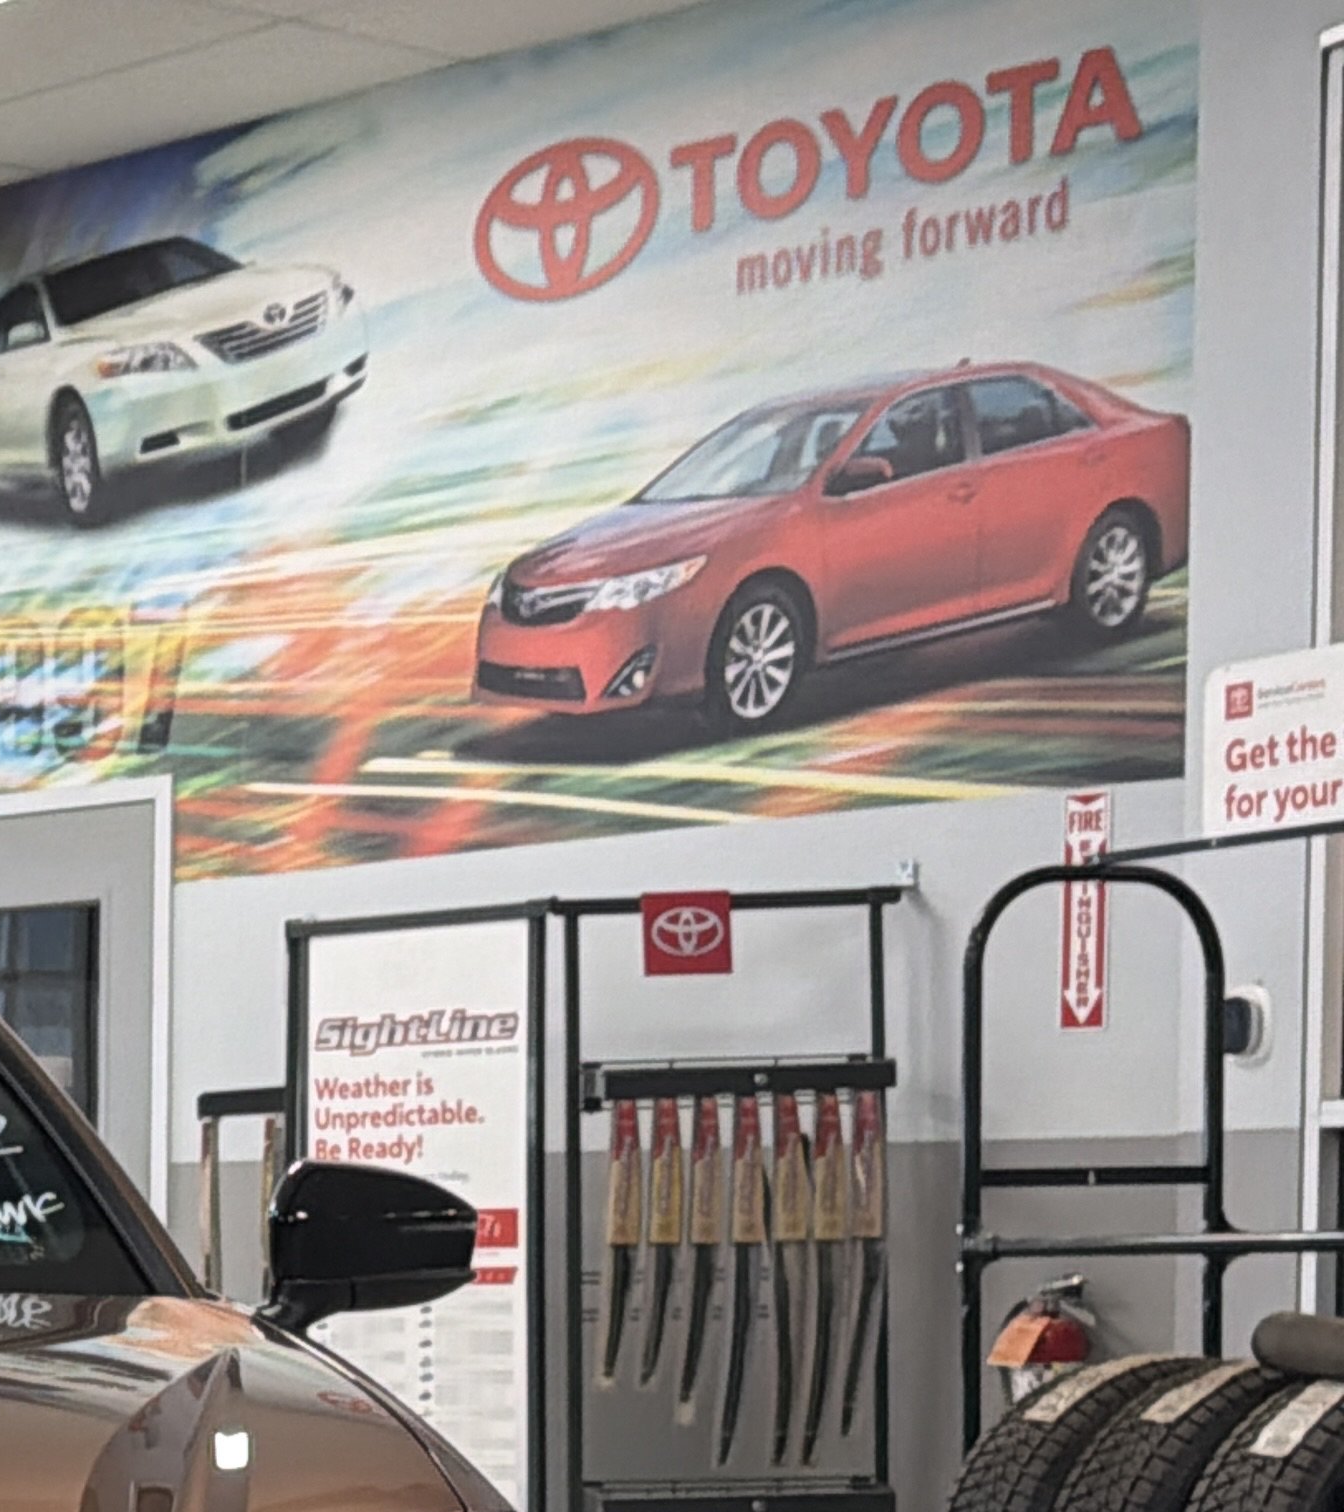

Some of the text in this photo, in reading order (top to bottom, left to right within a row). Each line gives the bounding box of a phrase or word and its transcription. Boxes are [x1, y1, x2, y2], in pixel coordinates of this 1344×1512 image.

[669, 44, 1143, 234] TOYOTA
[735, 175, 1071, 296] moving forward
[1225, 724, 1337, 773] Get the
[1068, 809, 1104, 833] FIRE
[1224, 779, 1343, 823] for your
[314, 1069, 435, 1101] Weather is
[314, 1098, 486, 1135] Unpredictable.
[315, 1134, 424, 1165] Be Ready!
